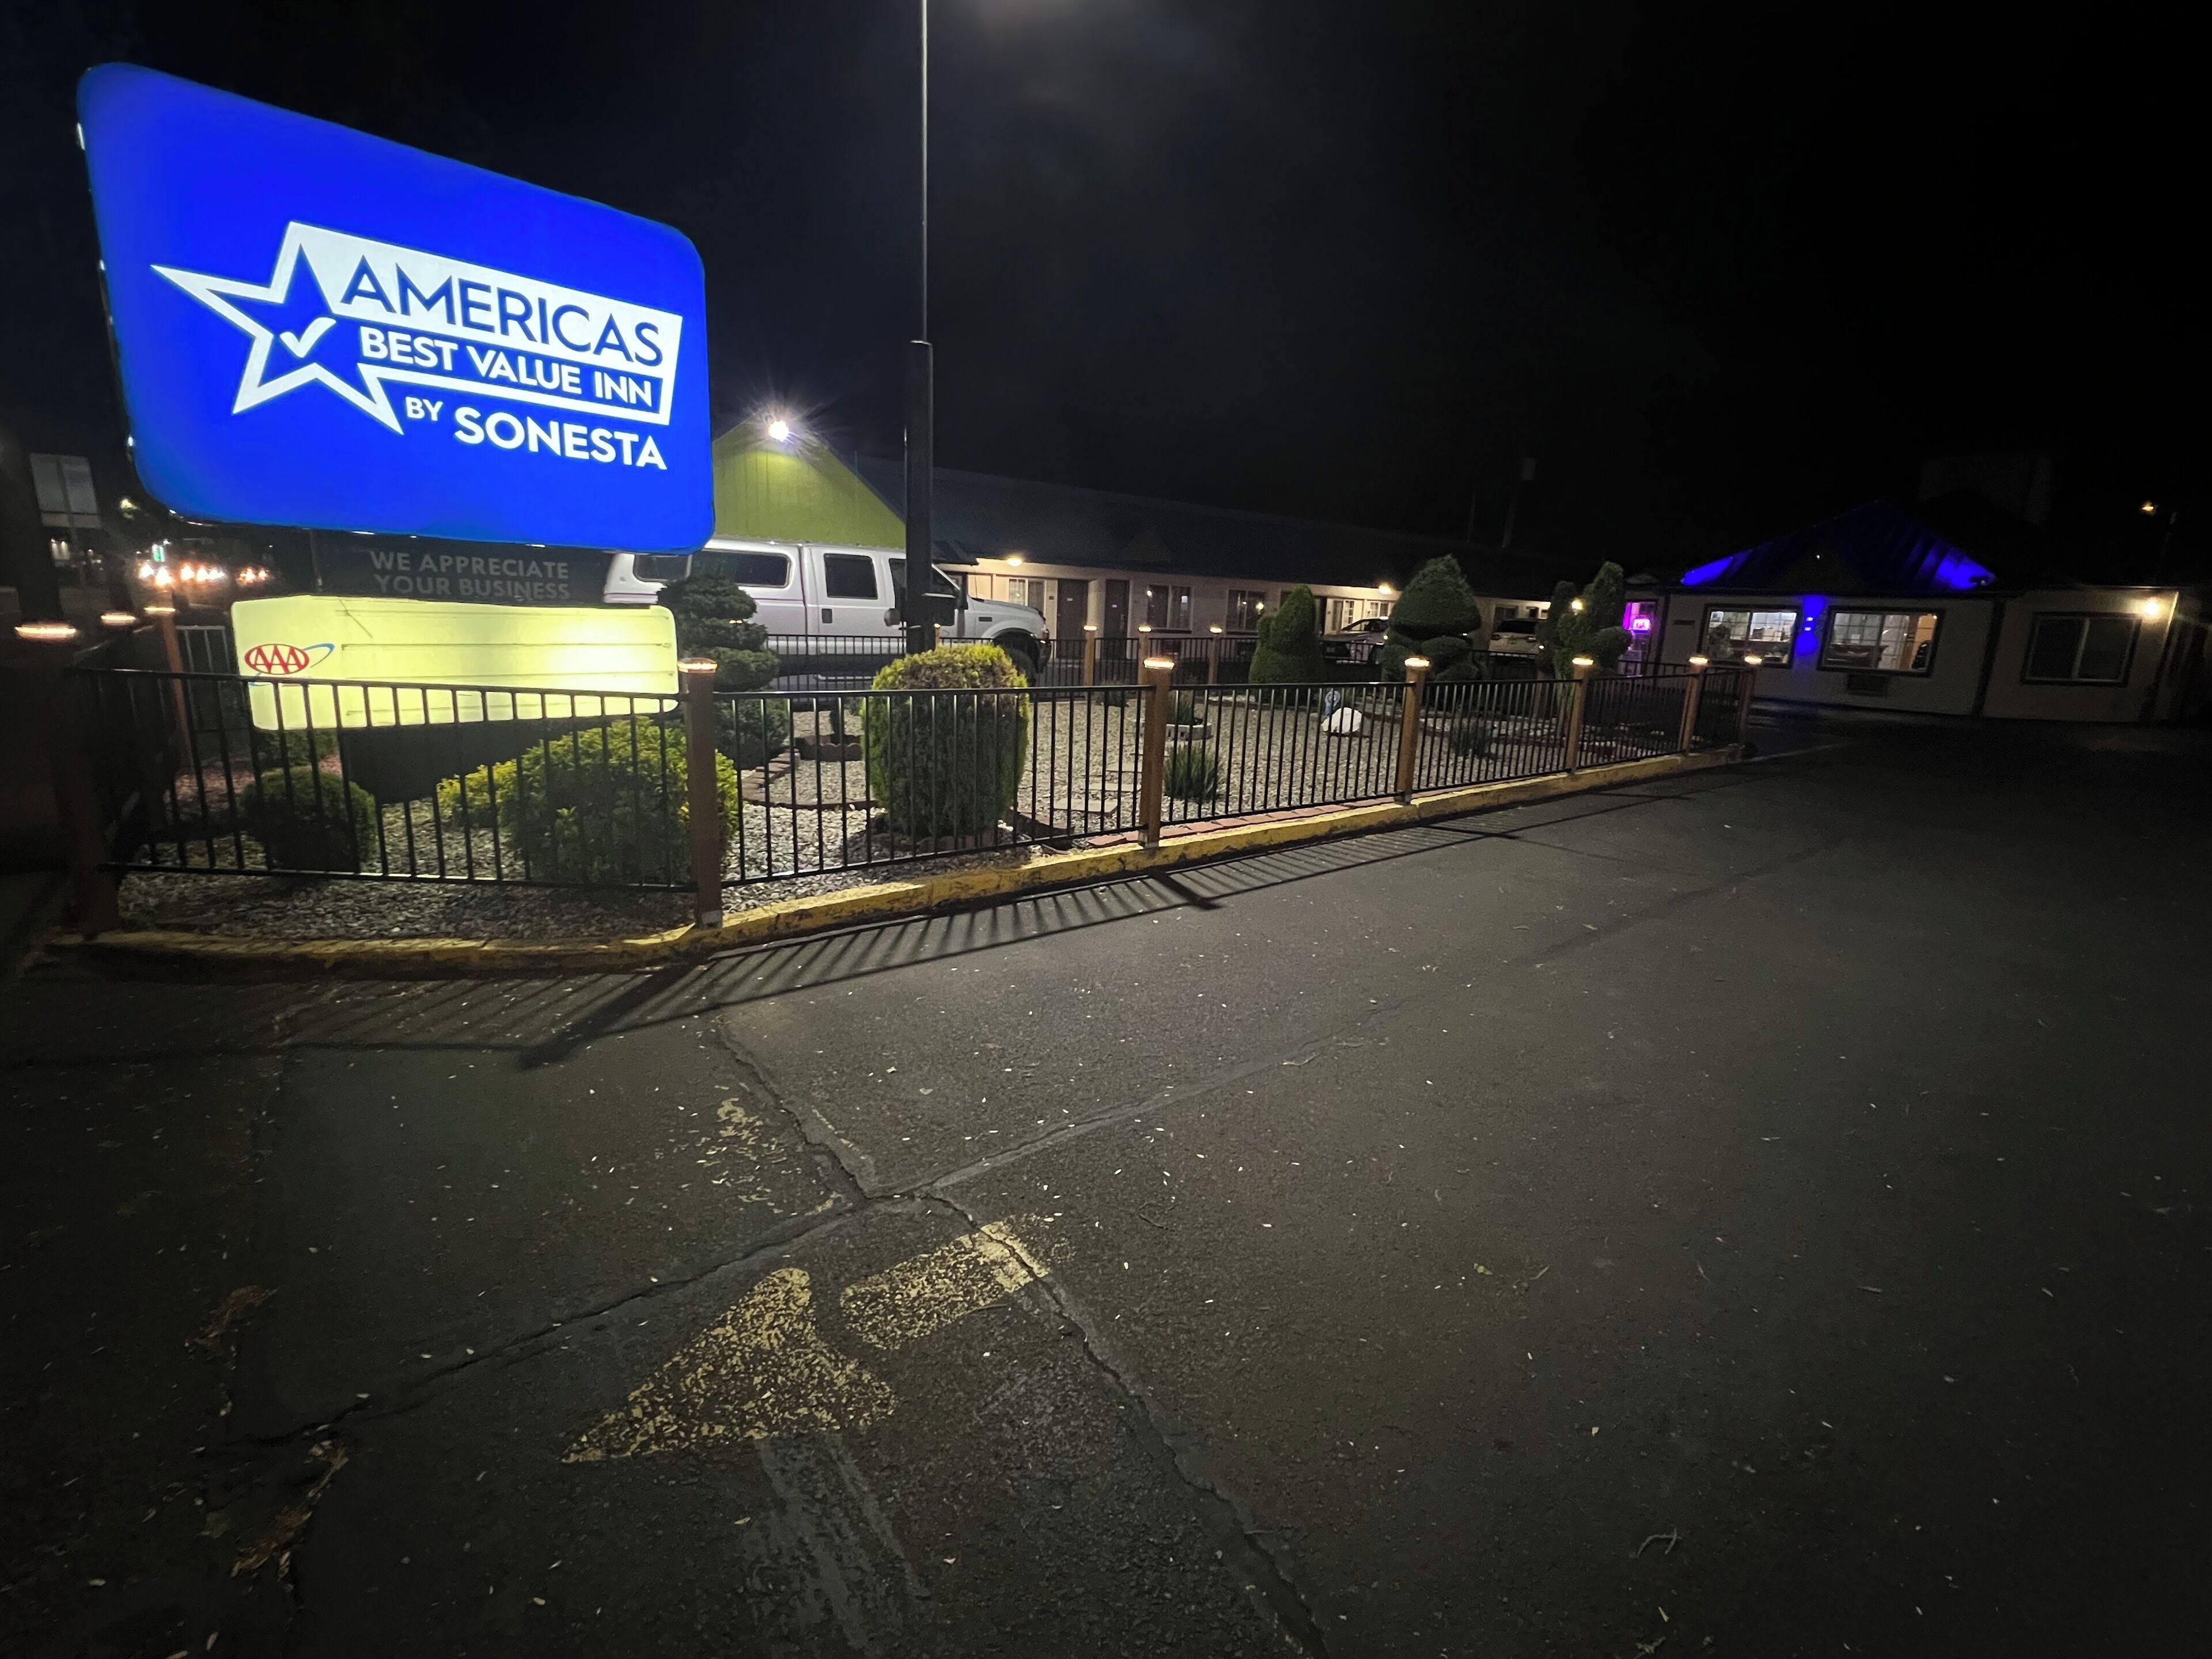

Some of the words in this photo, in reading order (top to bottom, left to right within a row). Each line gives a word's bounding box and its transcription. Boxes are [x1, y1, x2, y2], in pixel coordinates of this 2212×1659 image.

[341, 255, 663, 365] AMERICAS
[361, 327, 459, 370] BEST
[467, 346, 581, 393] VALUE
[594, 372, 652, 407] INN
[406, 397, 443, 421] BY
[454, 407, 667, 469] SONESTA
[369, 551, 410, 571] WE
[419, 553, 569, 579] APPRECIATE
[374, 575, 450, 595] YOUR
[460, 578, 570, 600] BUSINESS
[252, 645, 306, 674] AAA
